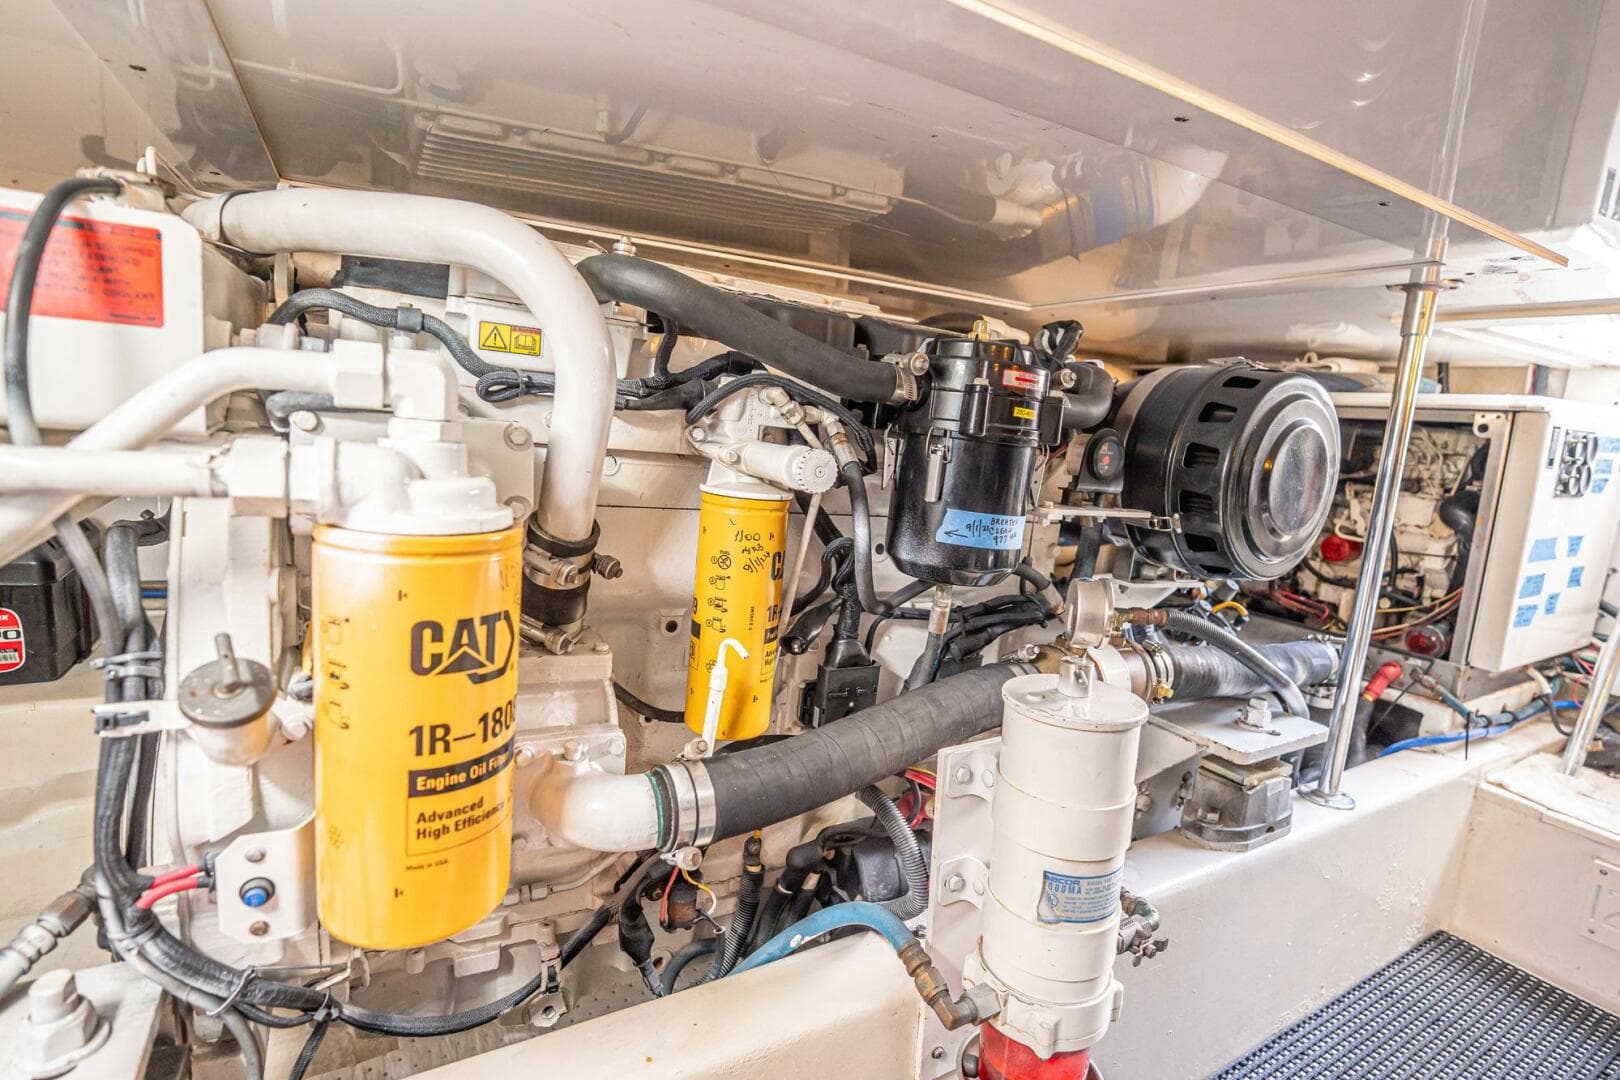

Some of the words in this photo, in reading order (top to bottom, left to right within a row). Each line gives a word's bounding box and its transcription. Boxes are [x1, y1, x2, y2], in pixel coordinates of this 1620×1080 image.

[410, 610, 508, 680] CAT
[416, 772, 467, 791] Engine
[469, 763, 487, 780] Oil
[416, 796, 484, 824] Advanced
[416, 824, 450, 841] High
